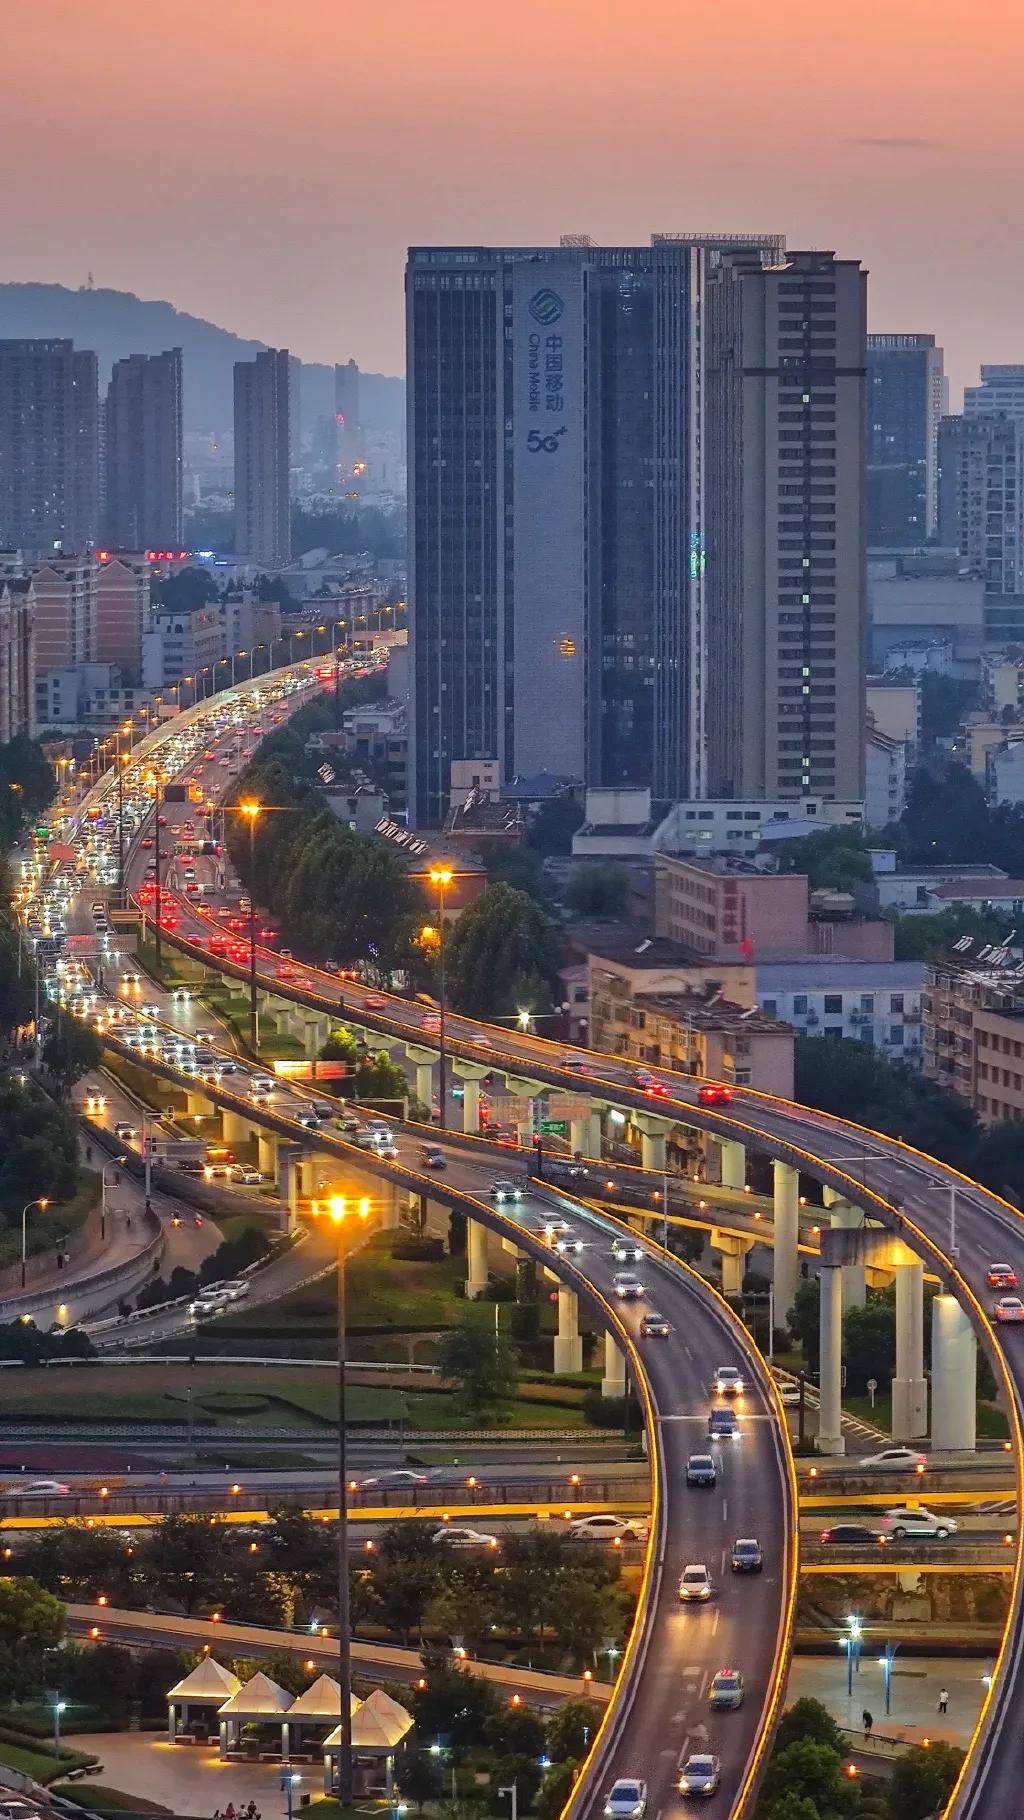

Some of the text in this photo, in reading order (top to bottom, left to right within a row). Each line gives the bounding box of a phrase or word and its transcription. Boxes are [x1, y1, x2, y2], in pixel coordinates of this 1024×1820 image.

[528, 333, 541, 412] China Mobile
[546, 334, 563, 412] 中国移动
